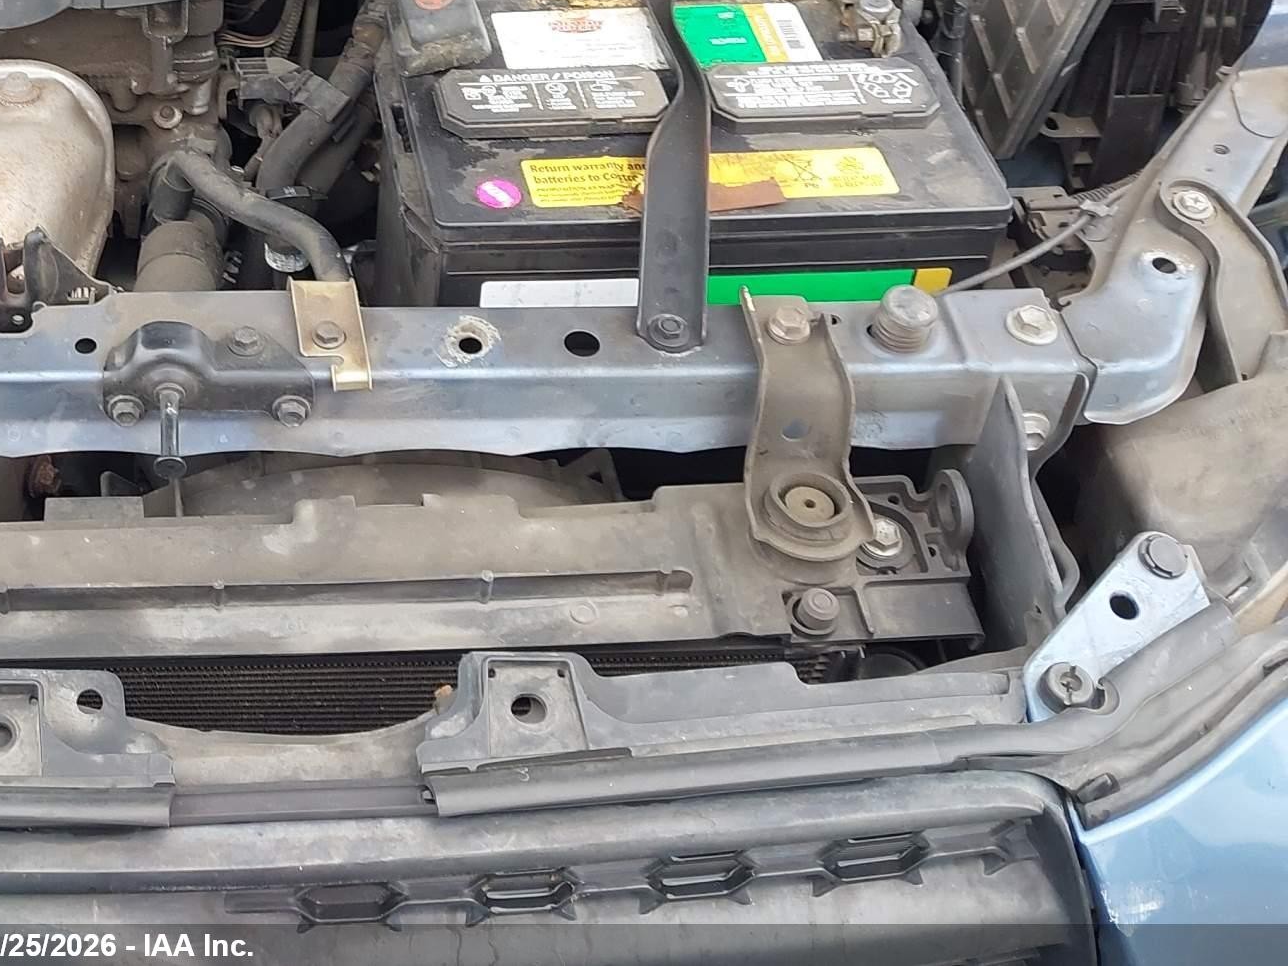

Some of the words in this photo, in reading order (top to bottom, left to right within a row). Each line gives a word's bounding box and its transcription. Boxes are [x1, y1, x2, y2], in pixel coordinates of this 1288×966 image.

[492, 73, 550, 83] DANGER
[562, 69, 616, 80] POISON
[529, 164, 570, 173] Return
[572, 162, 624, 172] warranty
[533, 174, 586, 184] batteries
[588, 174, 600, 182] to
